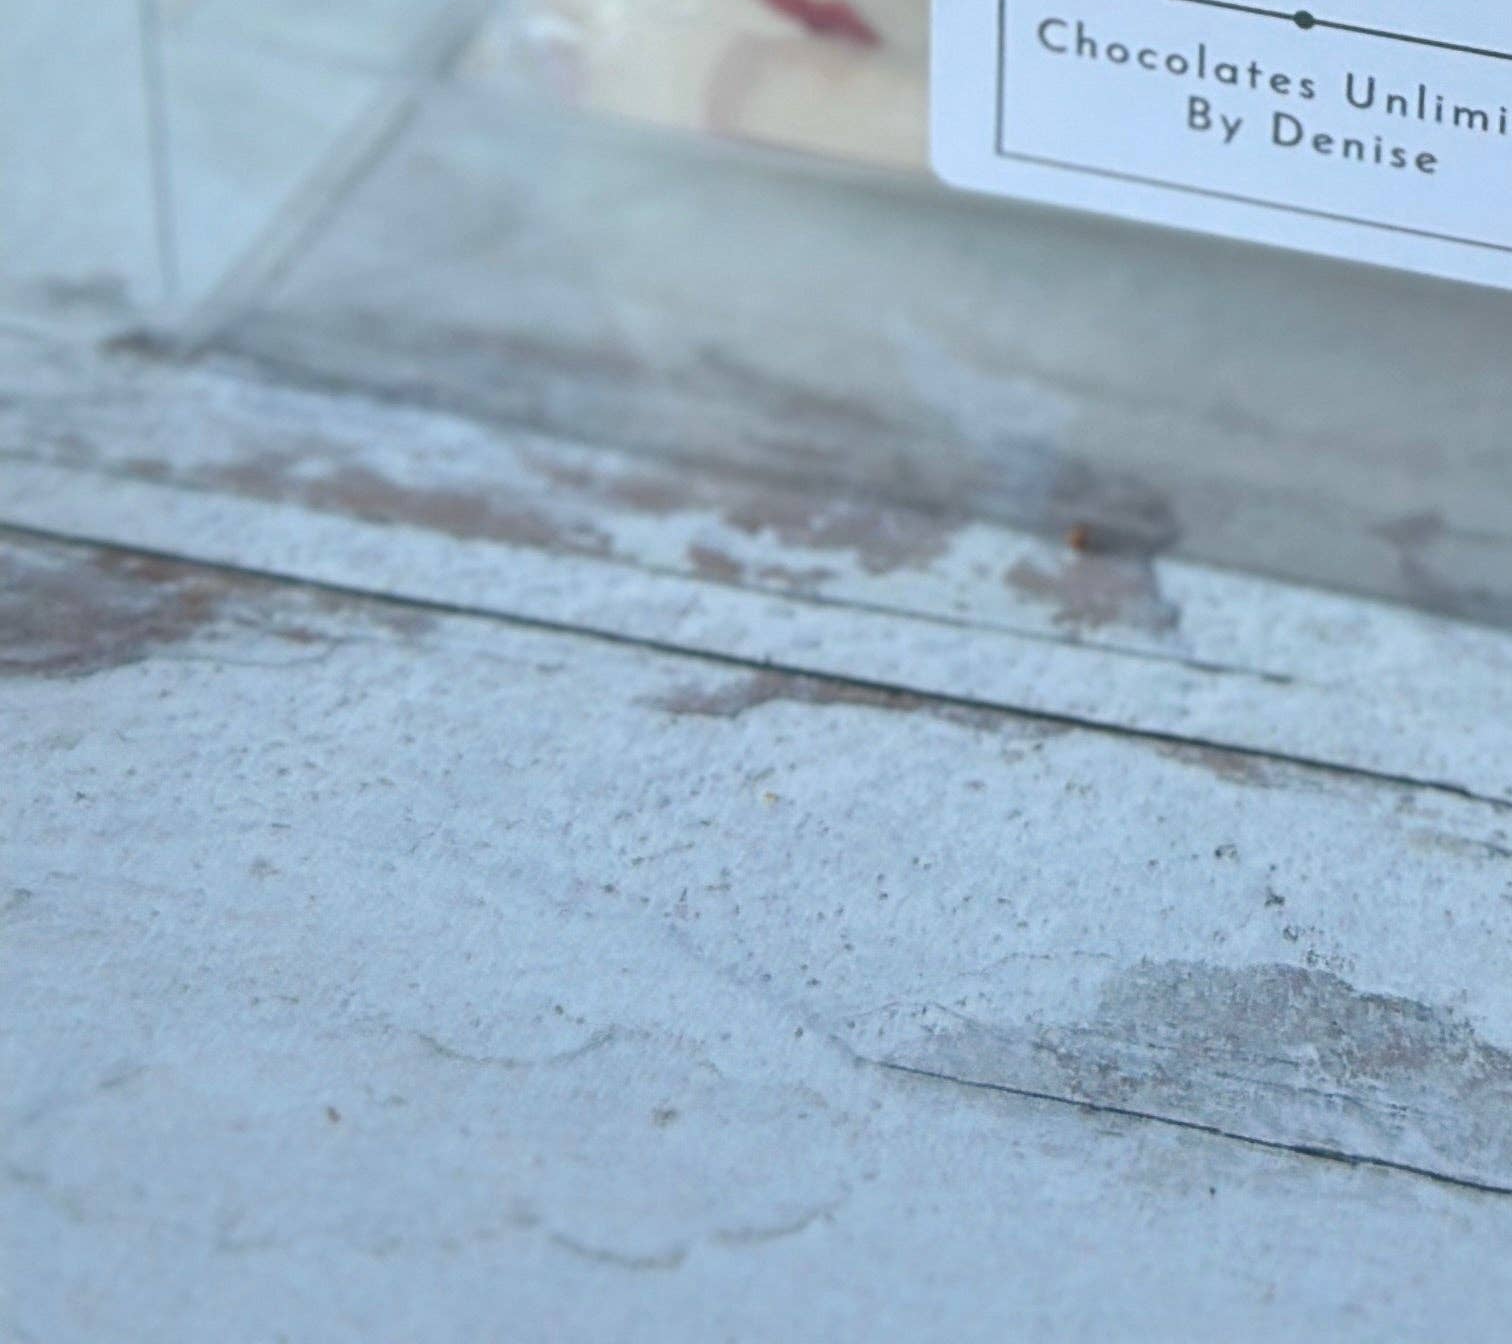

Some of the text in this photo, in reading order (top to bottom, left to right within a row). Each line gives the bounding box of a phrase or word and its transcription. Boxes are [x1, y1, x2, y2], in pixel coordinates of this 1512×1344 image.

[1036, 16, 1317, 102] Chocolates
[1186, 94, 1440, 177] By Denise
